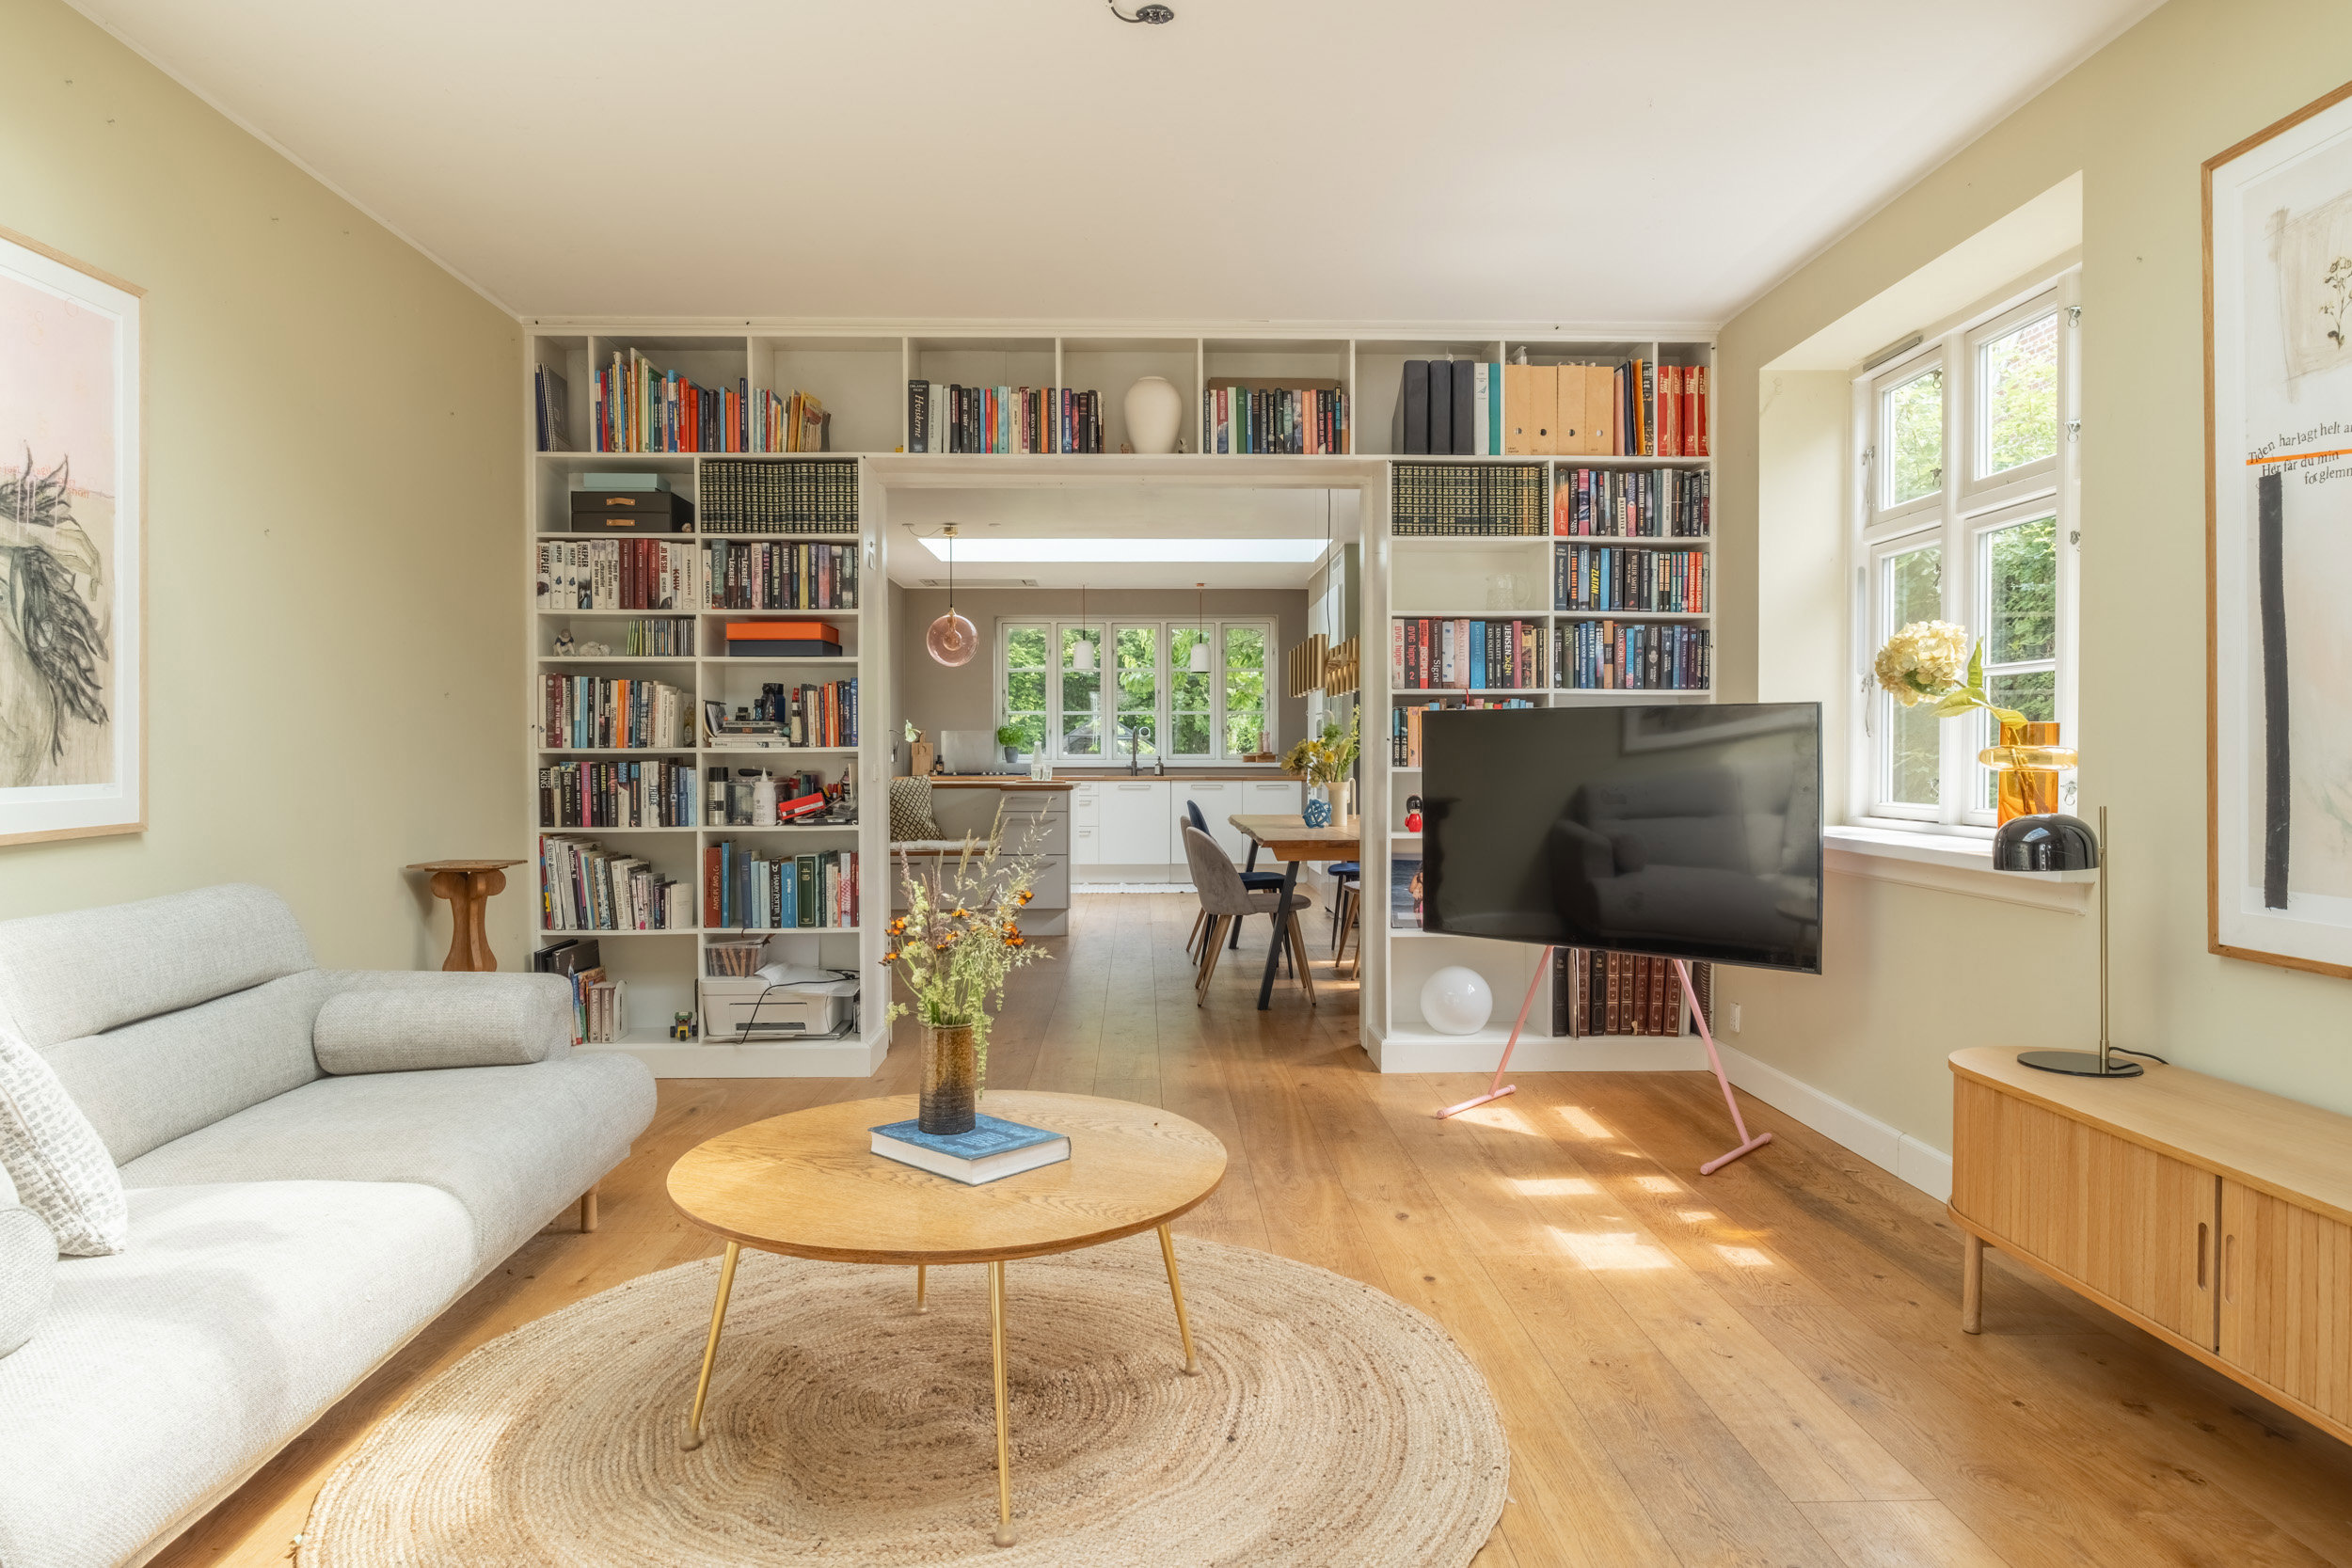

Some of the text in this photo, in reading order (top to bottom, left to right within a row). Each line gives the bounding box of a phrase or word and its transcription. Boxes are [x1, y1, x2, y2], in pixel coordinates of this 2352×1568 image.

[914, 394, 924, 438] Hviskerne
[2249, 441, 2275, 463] Tiden
[2279, 434, 2296, 447] har
[2296, 428, 2317, 444] lagt
[2320, 422, 2340, 436] helt
[2262, 464, 2280, 477] Her
[2301, 455, 2314, 468] du
[2317, 450, 2339, 464] min
[541, 549, 549, 574] KEPLER
[1591, 568, 1599, 594] ZLATAN
[1394, 645, 1403, 666] hippie
[1407, 626, 1416, 680] ØVIG hippie 2
[1431, 659, 1441, 683] Signe
[615, 881, 624, 920] PICTOPLASMA
